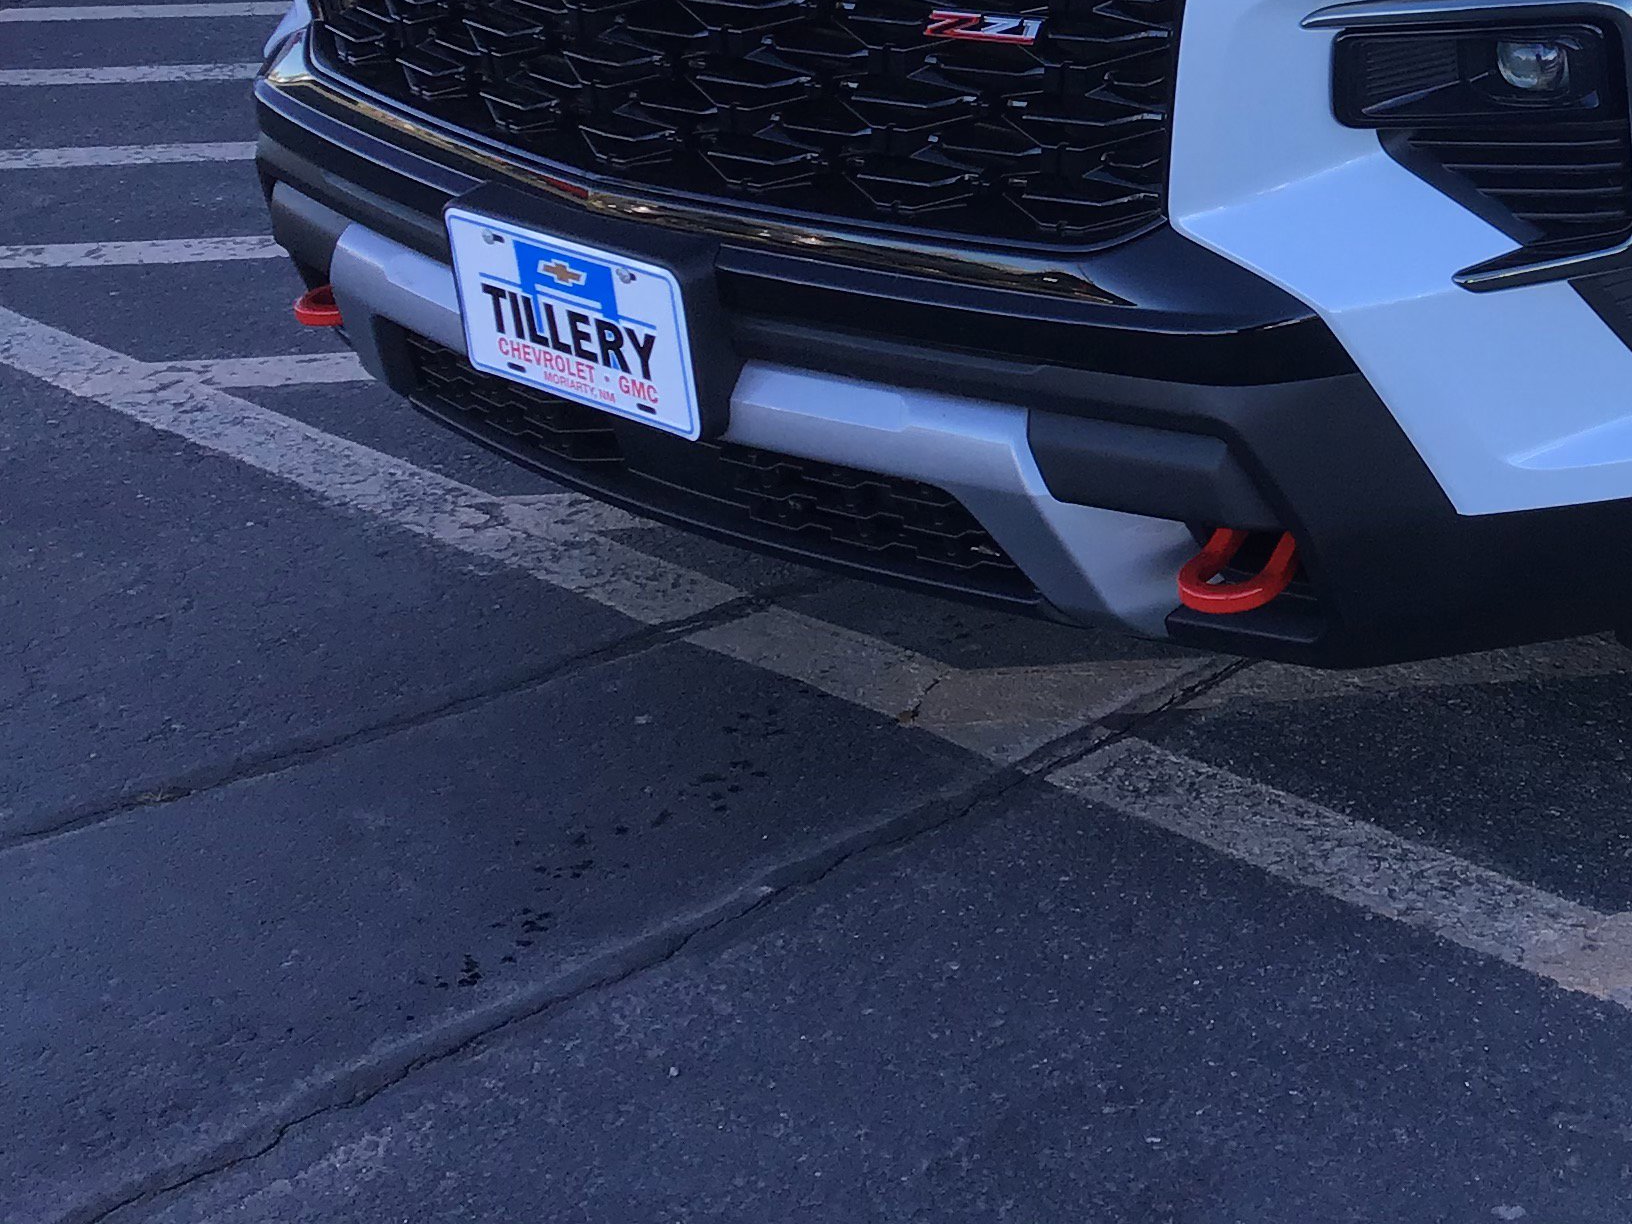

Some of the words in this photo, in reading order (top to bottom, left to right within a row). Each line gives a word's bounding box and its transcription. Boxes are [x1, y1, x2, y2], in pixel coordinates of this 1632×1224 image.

[923, 9, 1043, 46] Z71
[480, 282, 657, 382] TILLERY
[497, 337, 595, 384] CHEVROLET
[618, 375, 659, 404] GMC
